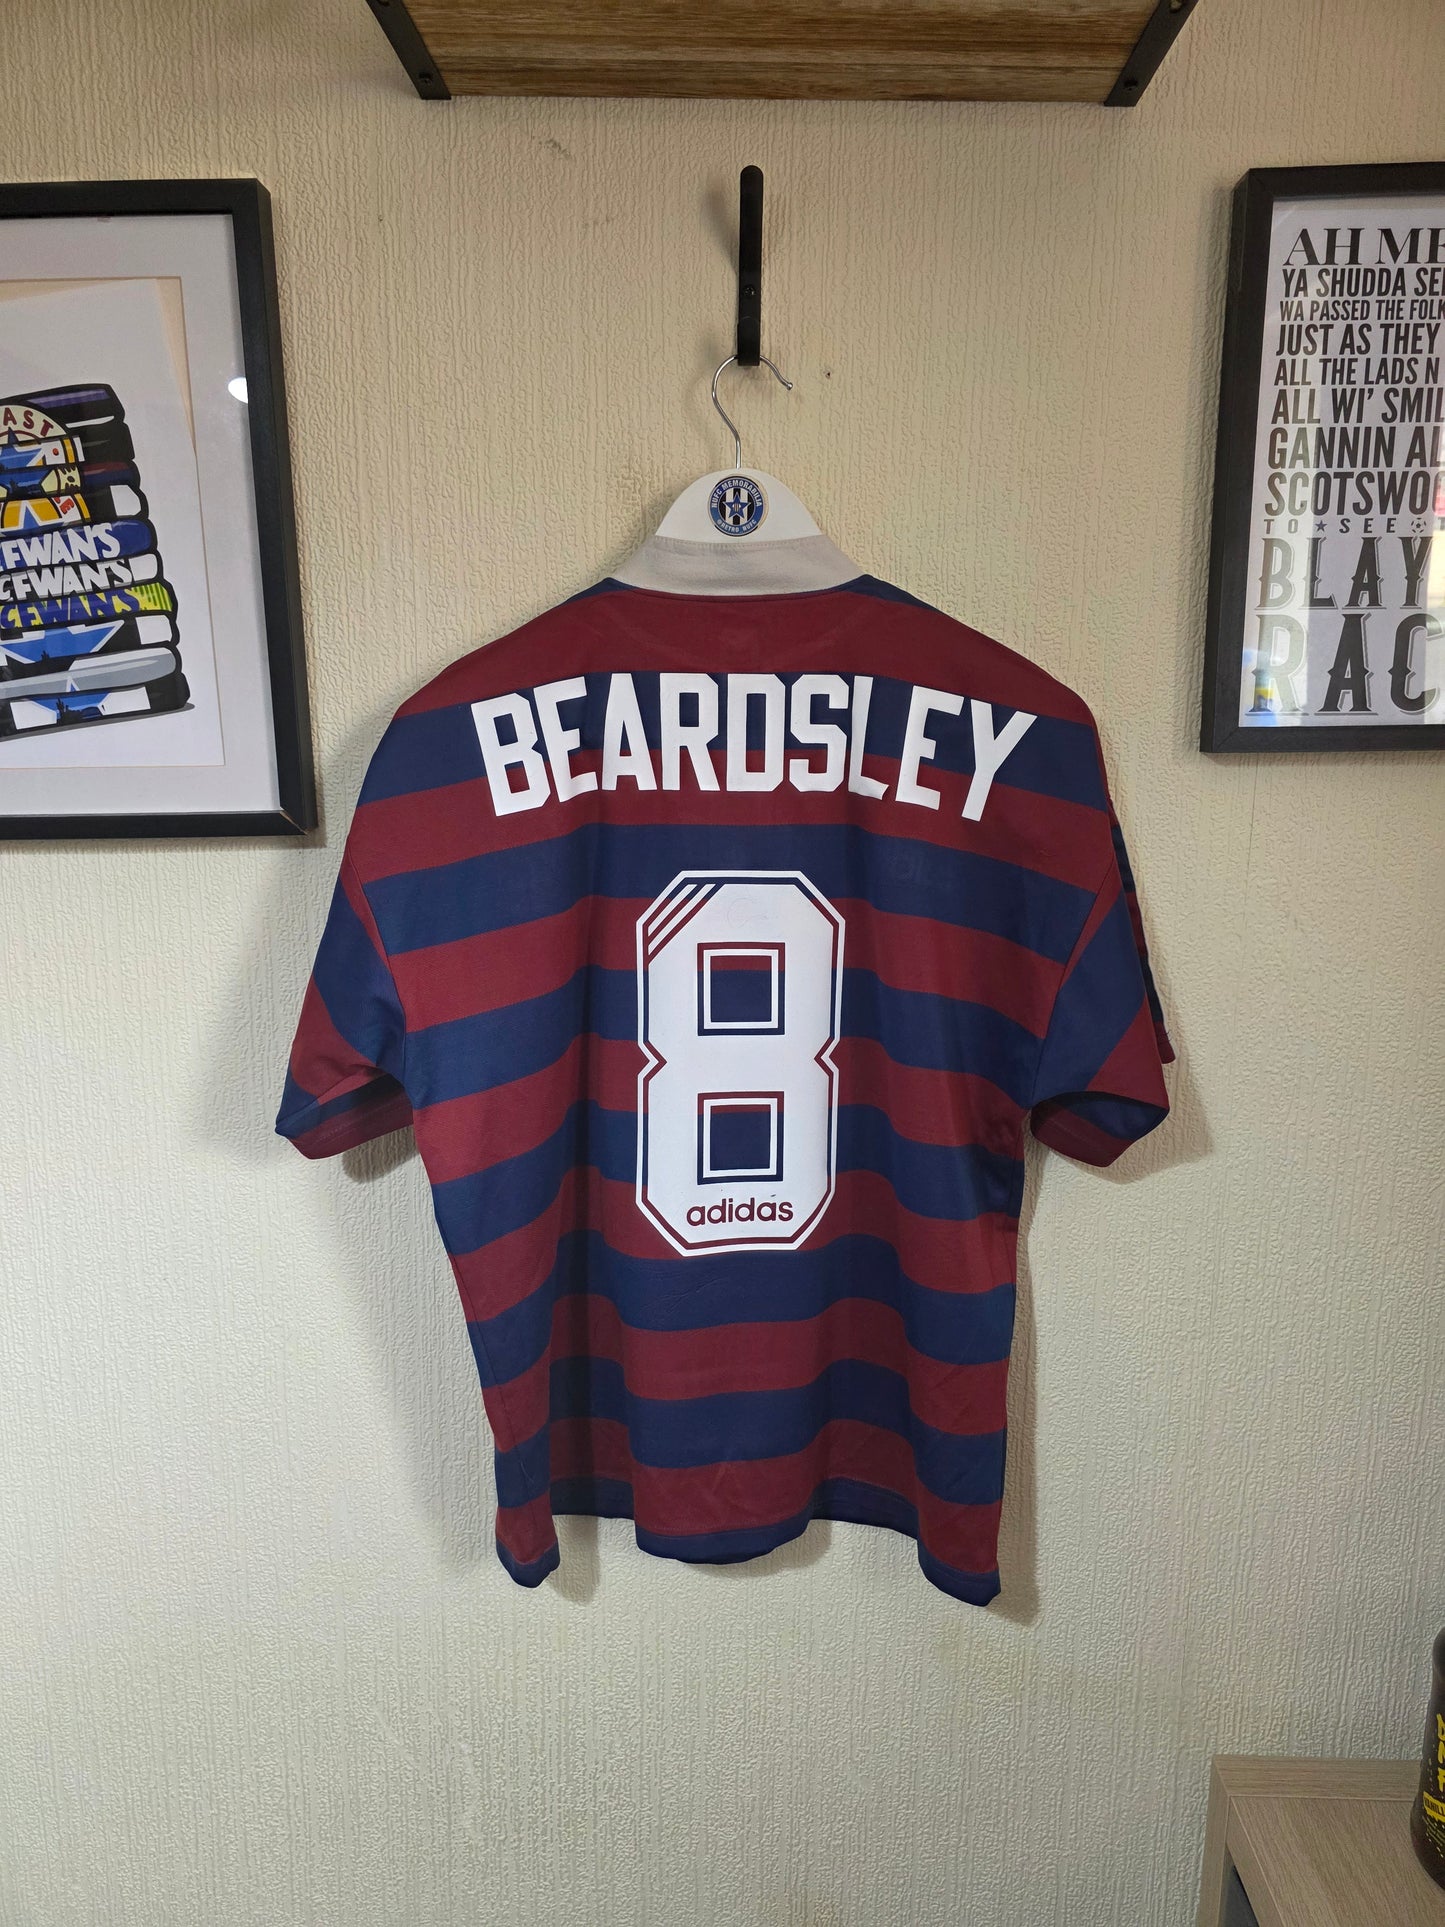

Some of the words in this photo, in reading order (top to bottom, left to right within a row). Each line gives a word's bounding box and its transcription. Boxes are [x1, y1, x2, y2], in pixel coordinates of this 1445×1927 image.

[1282, 228, 1365, 266] AH
[1282, 268, 1309, 298] YA
[1316, 267, 1407, 297] SHUDDA
[1279, 300, 1305, 322] WA
[1309, 300, 1370, 321] PASSED
[1376, 299, 1408, 321] THE
[1276, 323, 1334, 356] JUST
[1339, 323, 1372, 355] AS
[1380, 322, 1441, 355] THEY
[1274, 358, 1312, 386] ALL
[1319, 358, 1358, 386] THE
[1364, 357, 1419, 385] LADS
[1271, 388, 1321, 425] ALL
[1331, 387, 1374, 423] WI'
[1267, 426, 1397, 470] GANNIN
[711, 488, 723, 508] NUFC
[721, 479, 762, 507] MEMORABILIA
[1339, 517, 1397, 534] SEE
[471, 673, 1038, 821] BEARDSLEY
[636, 870, 846, 1257] 8
[686, 1197, 794, 1227] adidas
